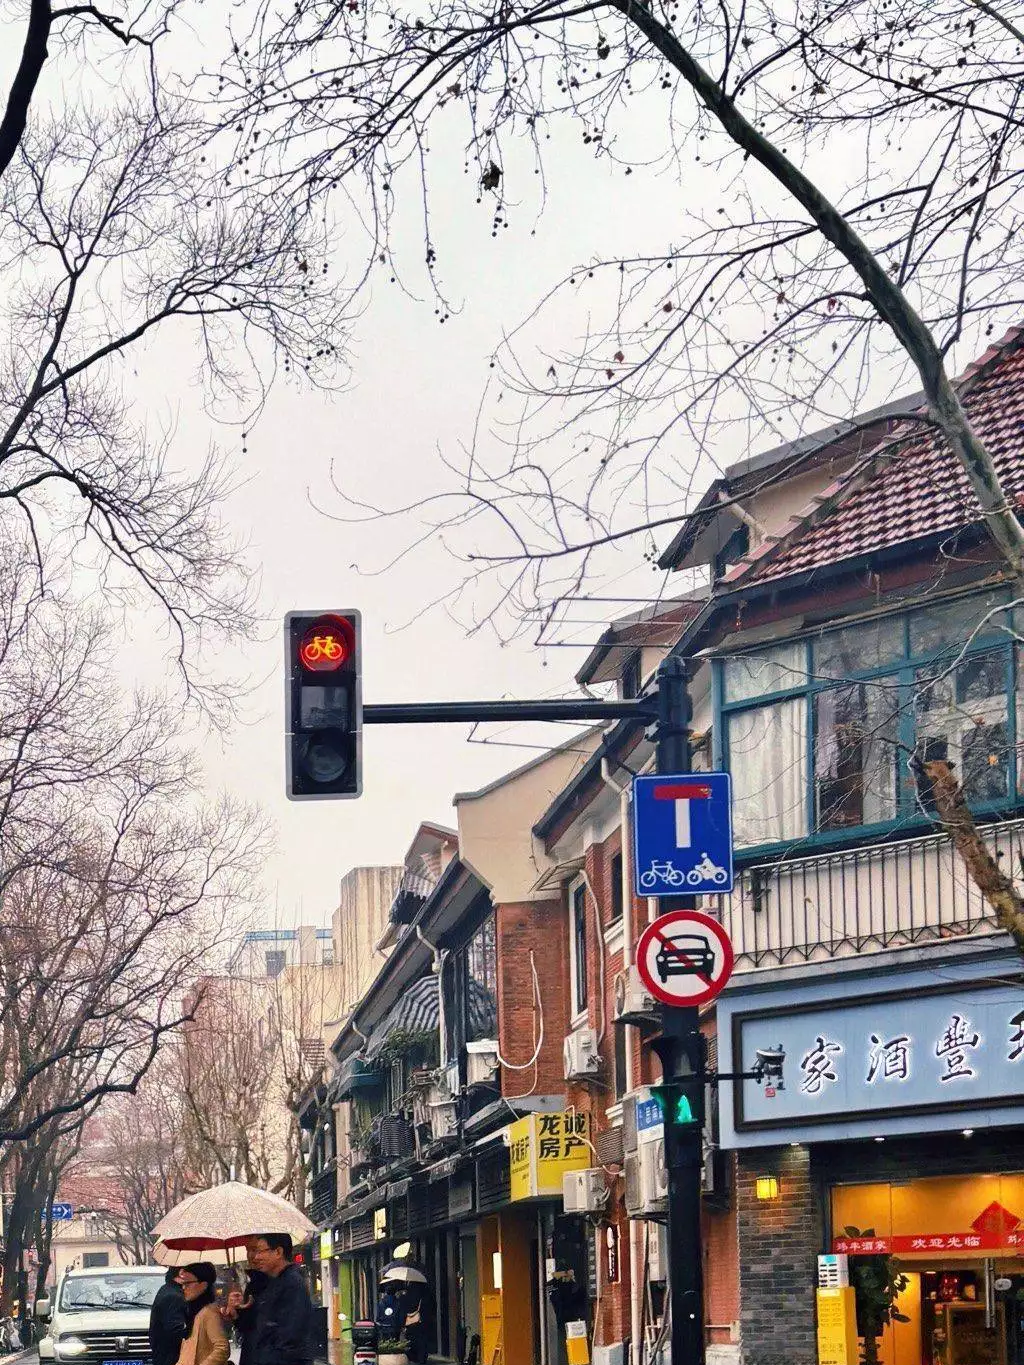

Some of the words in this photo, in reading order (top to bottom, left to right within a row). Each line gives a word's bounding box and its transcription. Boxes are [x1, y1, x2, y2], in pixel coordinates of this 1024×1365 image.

[538, 1112, 587, 1136] 龙诚
[538, 1135, 587, 1160] 房产
[911, 1235, 982, 1249] 欢迎光临
